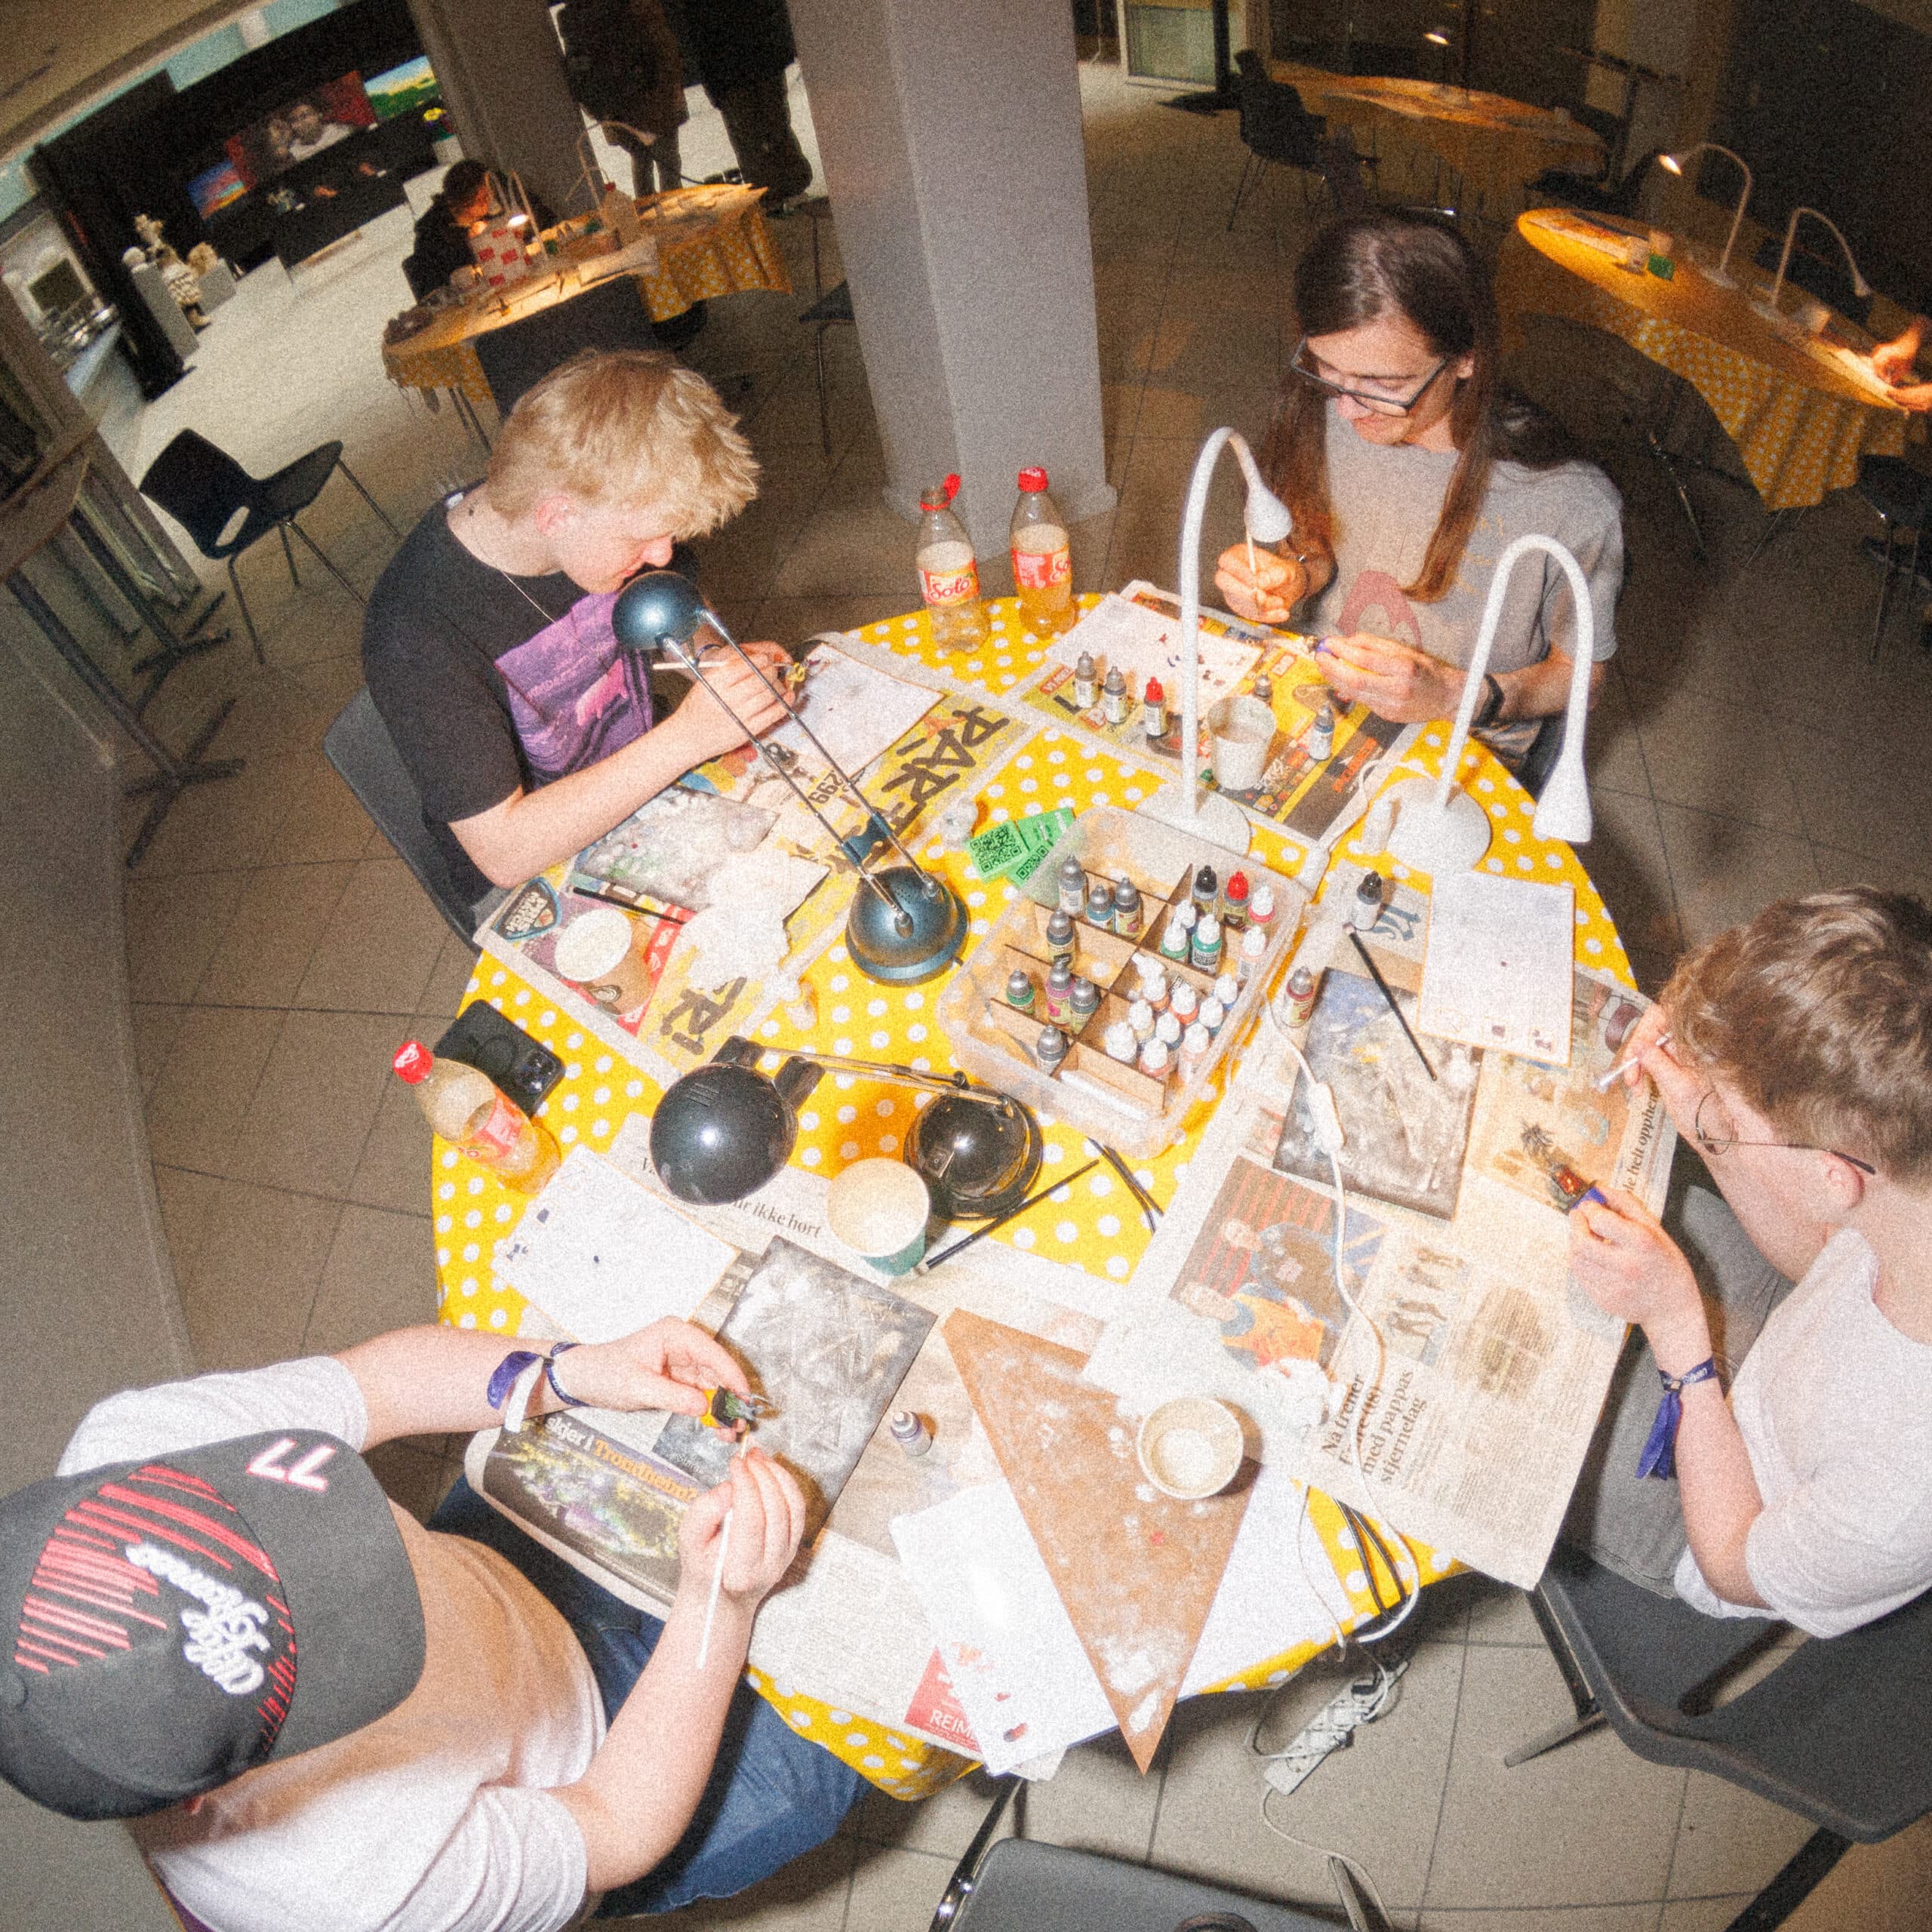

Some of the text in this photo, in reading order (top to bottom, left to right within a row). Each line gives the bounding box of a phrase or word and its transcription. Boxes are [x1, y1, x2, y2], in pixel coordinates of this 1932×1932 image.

[930, 577, 971, 601] Solo
[752, 1202, 786, 1225] ikke
[543, 1413, 587, 1446] skjer
[1321, 1374, 1364, 1456] Nå trener
[1361, 1369, 1414, 1475] med pappas
[1380, 1398, 1426, 1484] stjernelag
[246, 1437, 337, 1492] 77
